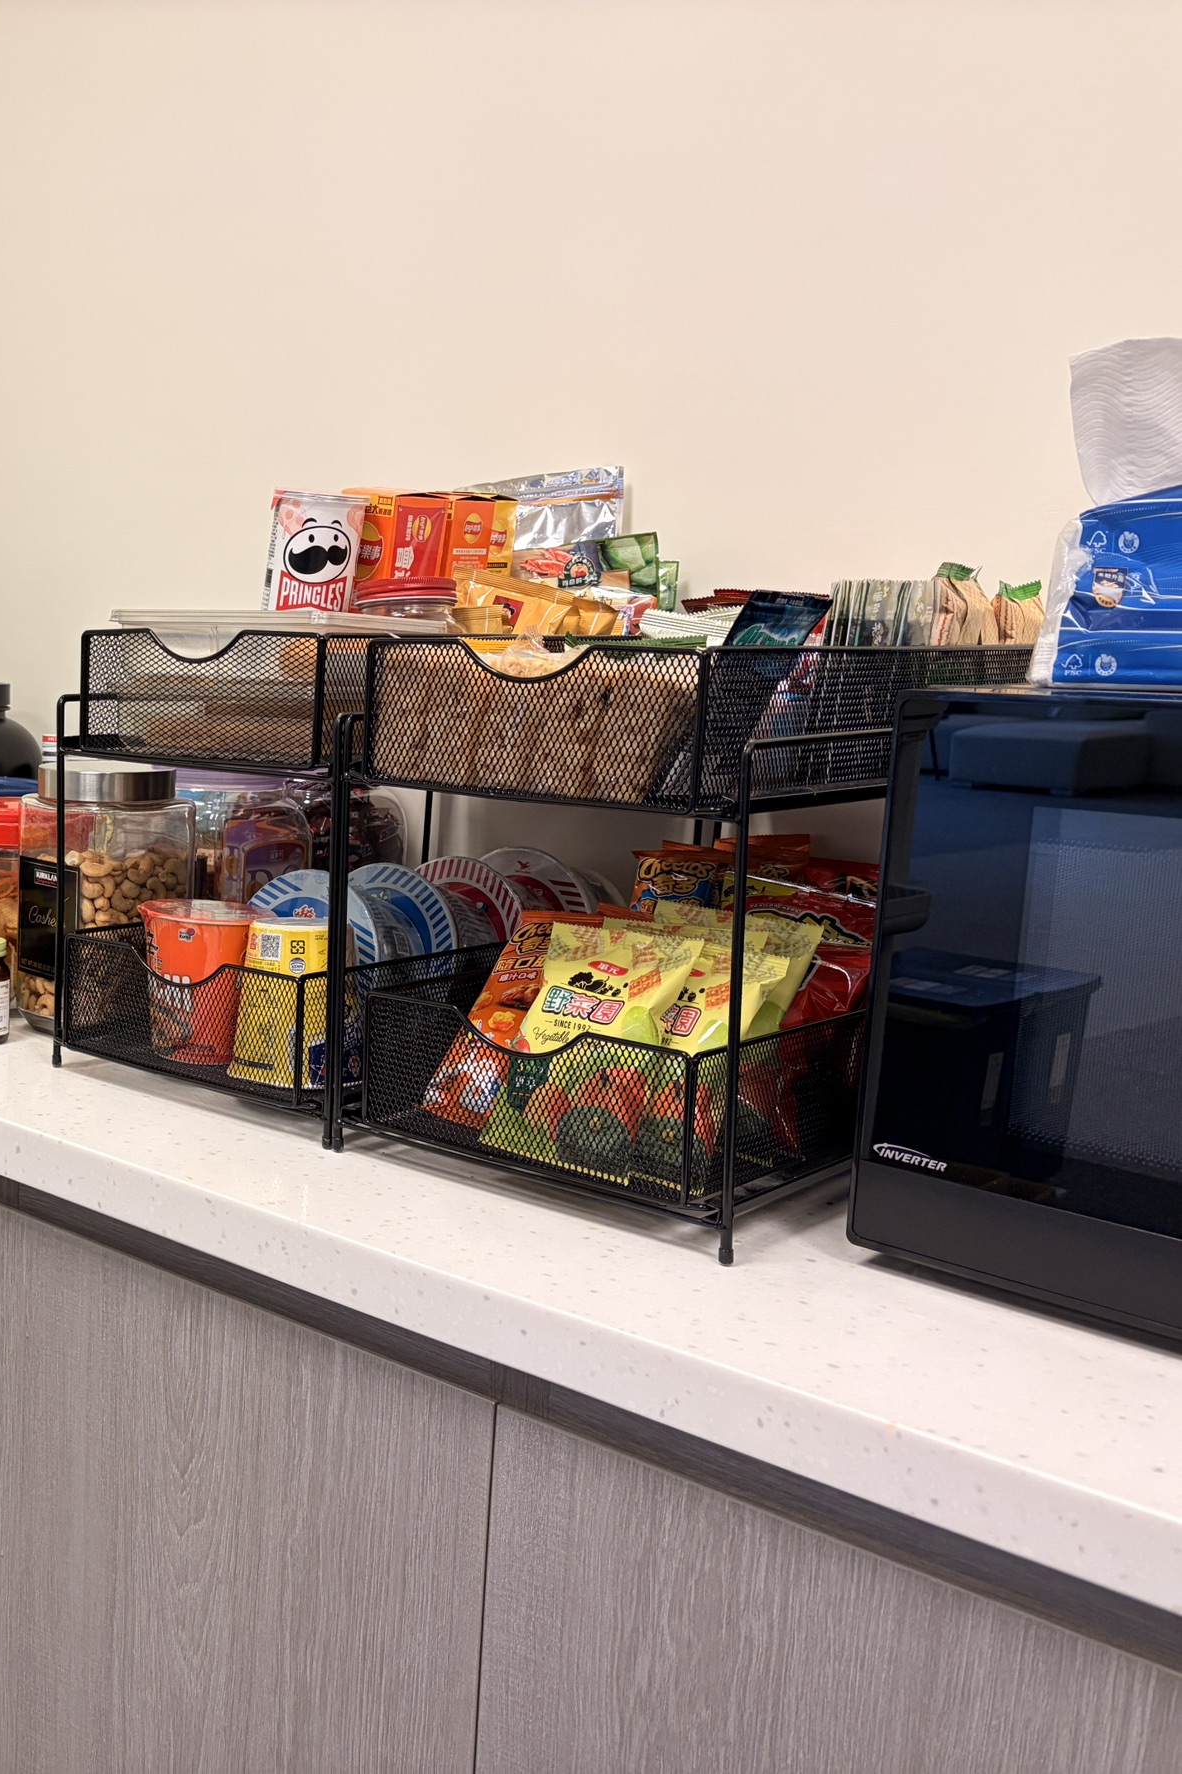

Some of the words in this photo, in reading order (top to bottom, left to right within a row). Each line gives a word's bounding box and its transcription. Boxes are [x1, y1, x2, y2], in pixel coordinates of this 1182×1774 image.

[279, 576, 344, 612] PRINGLES
[35, 870, 57, 882] KIRKLAN
[639, 858, 713, 879] Cheetos
[652, 873, 698, 895] 奇多
[28, 905, 66, 929] Cashe
[598, 962, 621, 976] 華元
[542, 985, 626, 1025] 野菜園
[554, 1019, 571, 1030] SINCE
[532, 1026, 569, 1045] Vegetable
[879, 1144, 947, 1172] INVERTER
